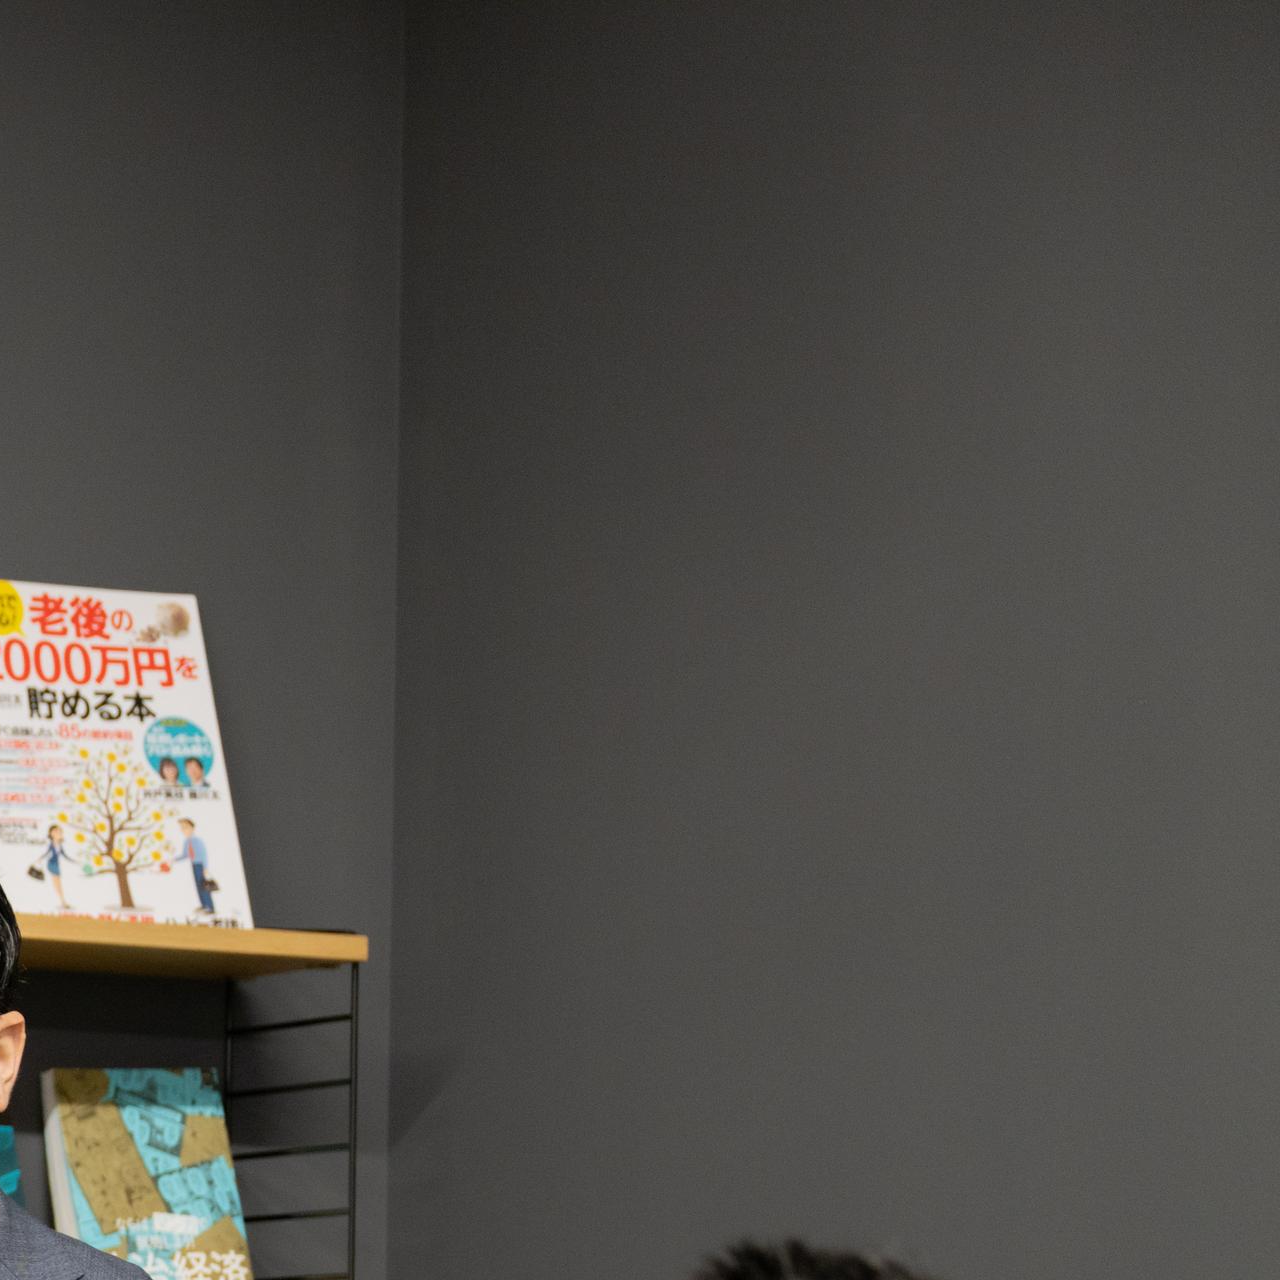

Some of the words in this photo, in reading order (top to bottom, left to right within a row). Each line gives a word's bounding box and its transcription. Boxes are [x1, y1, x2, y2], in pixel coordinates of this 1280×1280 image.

[29, 593, 134, 640] 老後の
[27, 686, 156, 723] 貯める本
